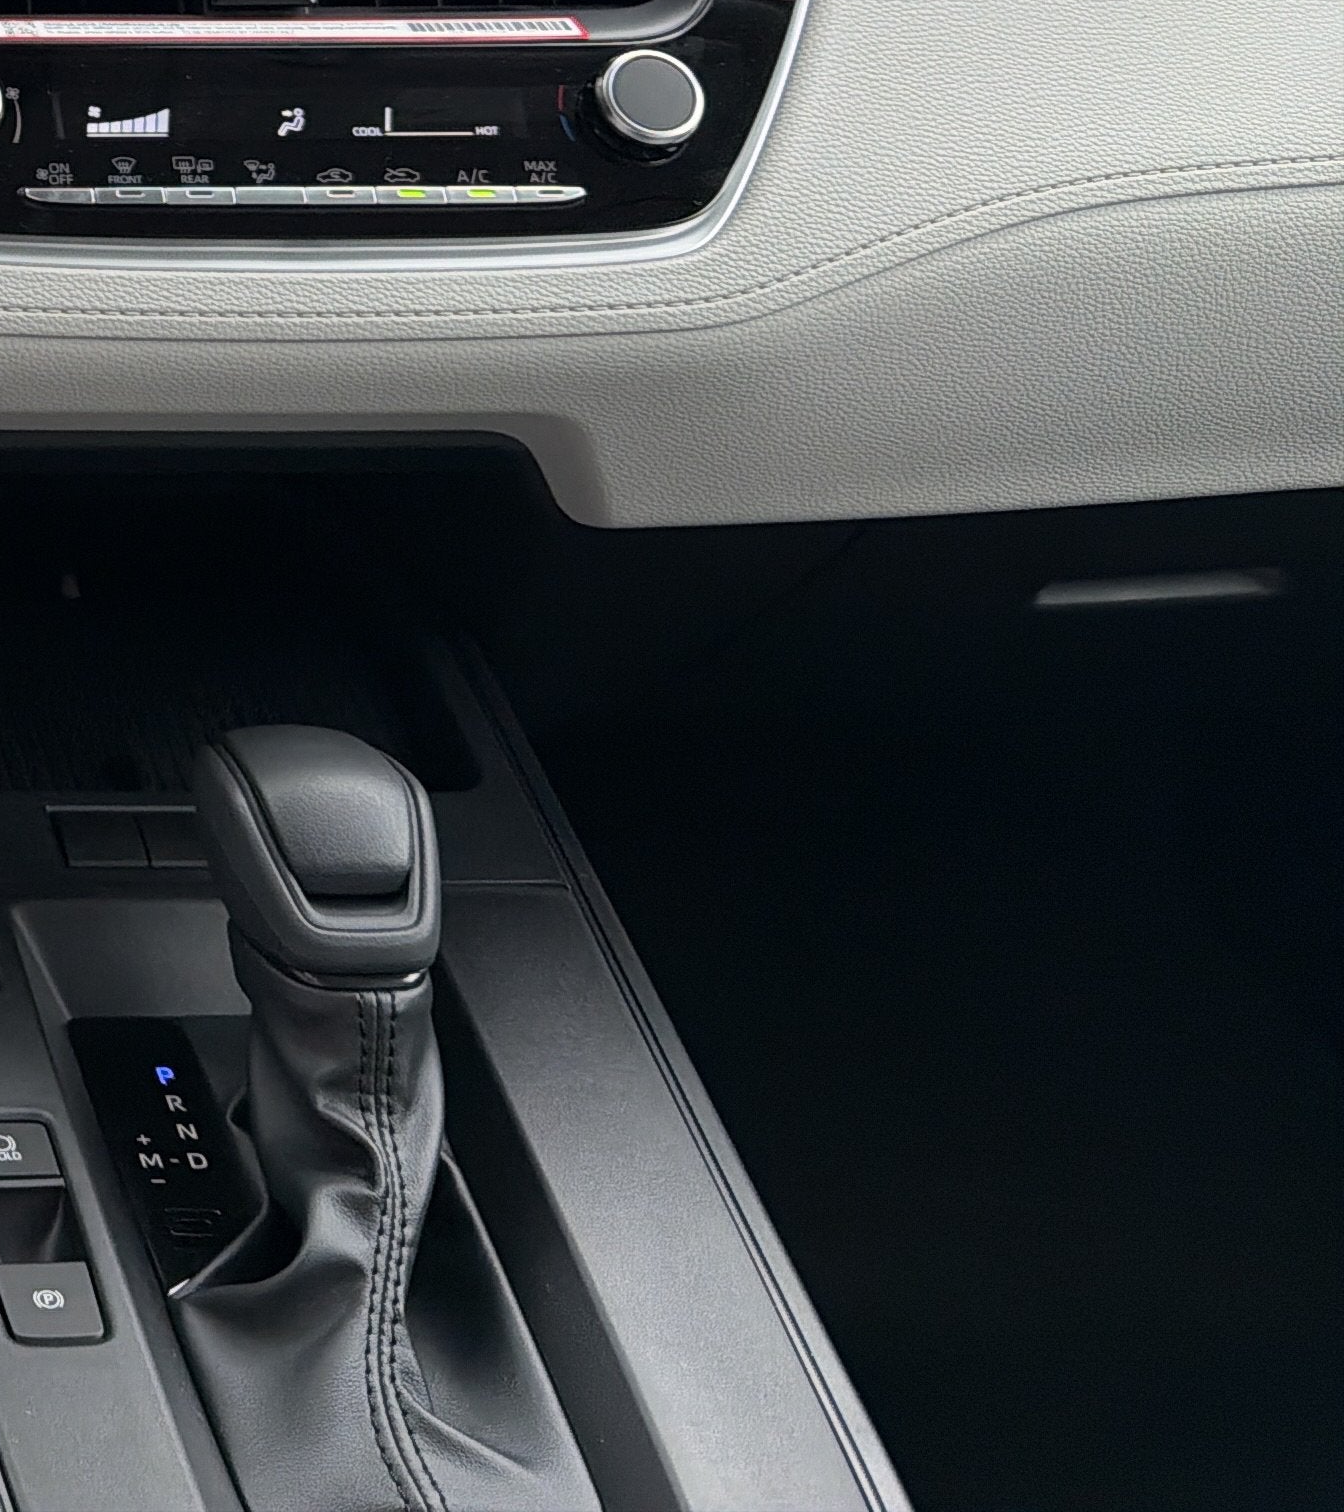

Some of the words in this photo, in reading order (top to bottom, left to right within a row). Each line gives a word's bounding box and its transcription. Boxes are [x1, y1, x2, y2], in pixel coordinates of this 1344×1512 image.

[352, 126, 383, 136] COOL
[475, 126, 499, 136] HOT
[49, 163, 69, 173] ON
[523, 160, 557, 172] MAX
[49, 174, 73, 185] OFF
[108, 175, 142, 184] FRONT
[181, 175, 209, 184] REAR
[457, 169, 490, 184] A/C
[530, 173, 557, 183] A/C
[156, 1066, 175, 1085] P
[165, 1095, 187, 1112] R
[176, 1123, 198, 1140] N
[139, 1153, 164, 1168] M
[187, 1152, 208, 1169] D
